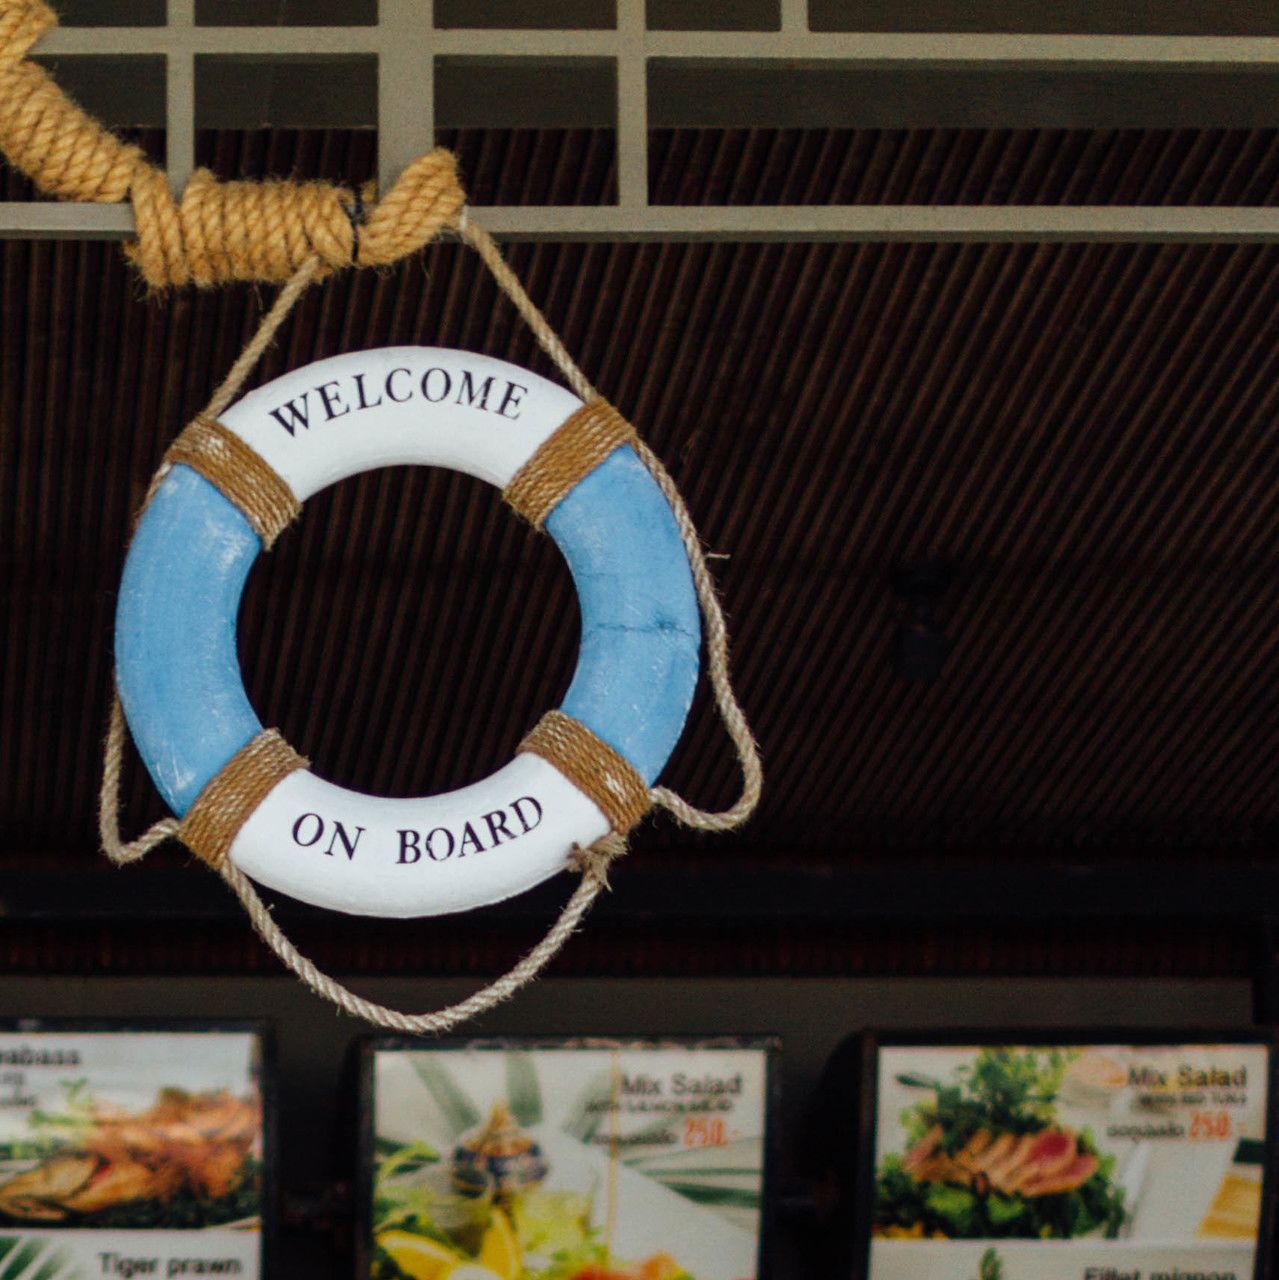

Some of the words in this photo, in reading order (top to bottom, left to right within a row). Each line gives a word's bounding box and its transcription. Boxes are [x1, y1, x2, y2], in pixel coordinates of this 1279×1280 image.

[268, 367, 528, 437] WELCOME
[292, 813, 366, 861] ON
[395, 796, 543, 864] BOARD
[621, 1073, 661, 1095] Mix
[673, 1072, 743, 1096] Salad
[1128, 1064, 1166, 1088] Mix
[1178, 1064, 1247, 1088] Salad
[98, 1252, 158, 1278] Tiger
[167, 1258, 242, 1279] prawn
